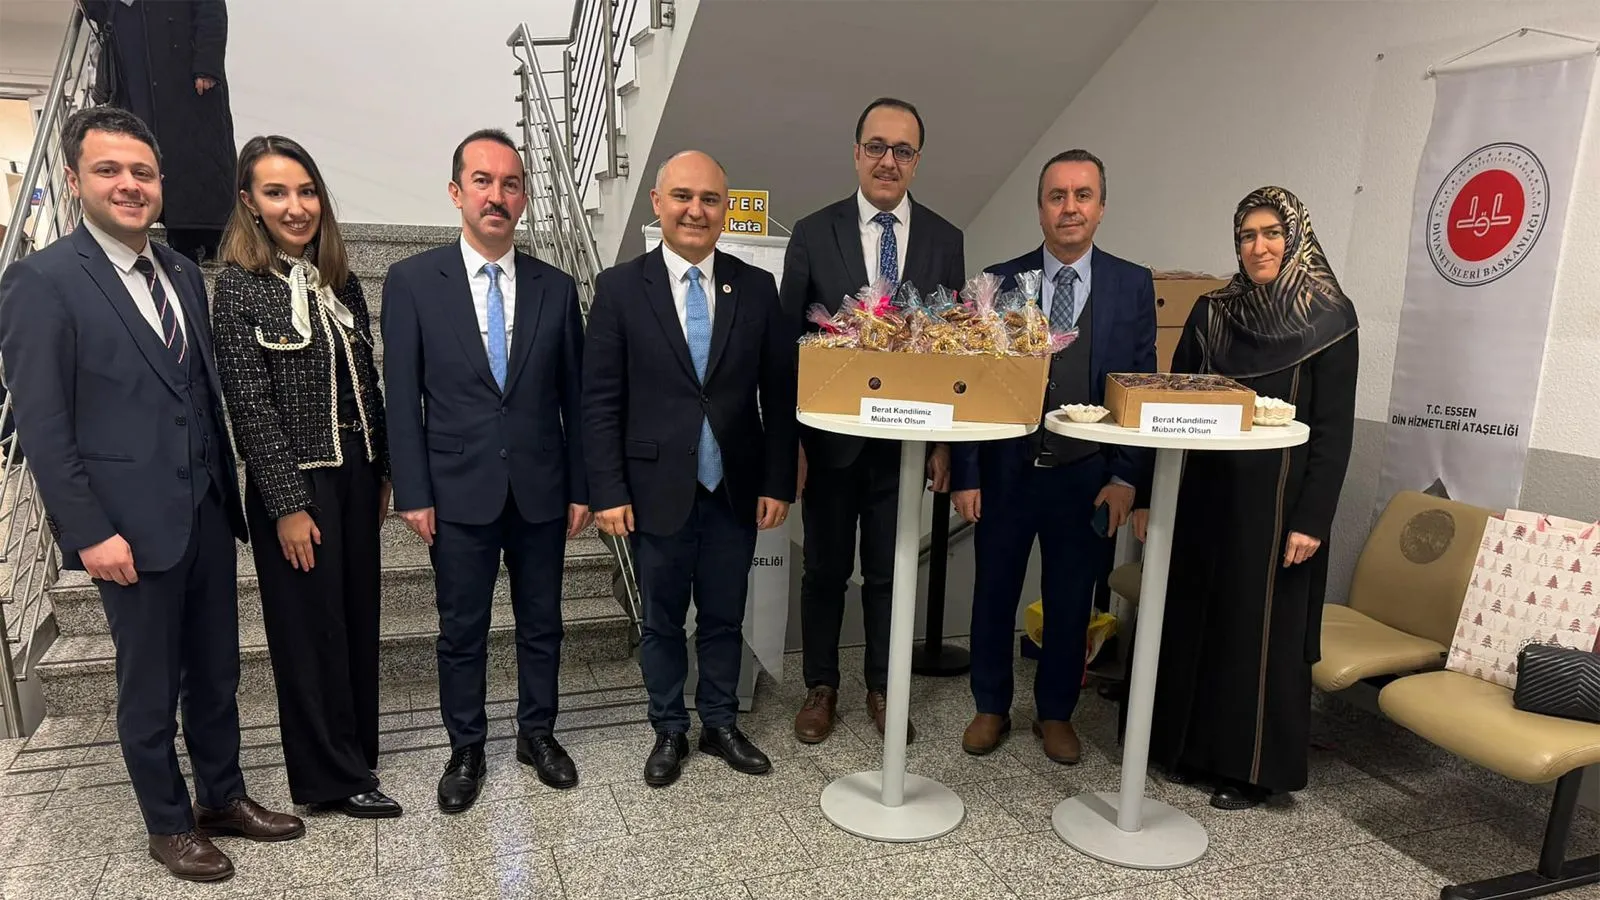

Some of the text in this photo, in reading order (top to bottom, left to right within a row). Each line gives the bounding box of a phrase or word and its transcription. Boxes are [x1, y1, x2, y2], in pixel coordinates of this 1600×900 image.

[728, 196, 765, 211] TER
[729, 218, 762, 232] kata
[1432, 213, 1540, 279] DİYANET İŞLERİ BAŞKANLIĞI
[871, 405, 932, 416] Berat Kandilimiz
[1426, 404, 1477, 418] T.C. ESSEN
[870, 415, 926, 425] Mübarek Olsun
[1152, 415, 1218, 425] Berat Kandilimiz
[1392, 413, 1519, 438] DİN HİZMETLERİ ATAŞELİĞİ
[1151, 425, 1212, 434] Mübarek Olsun
[752, 556, 783, 567] ŞELİĞİ
